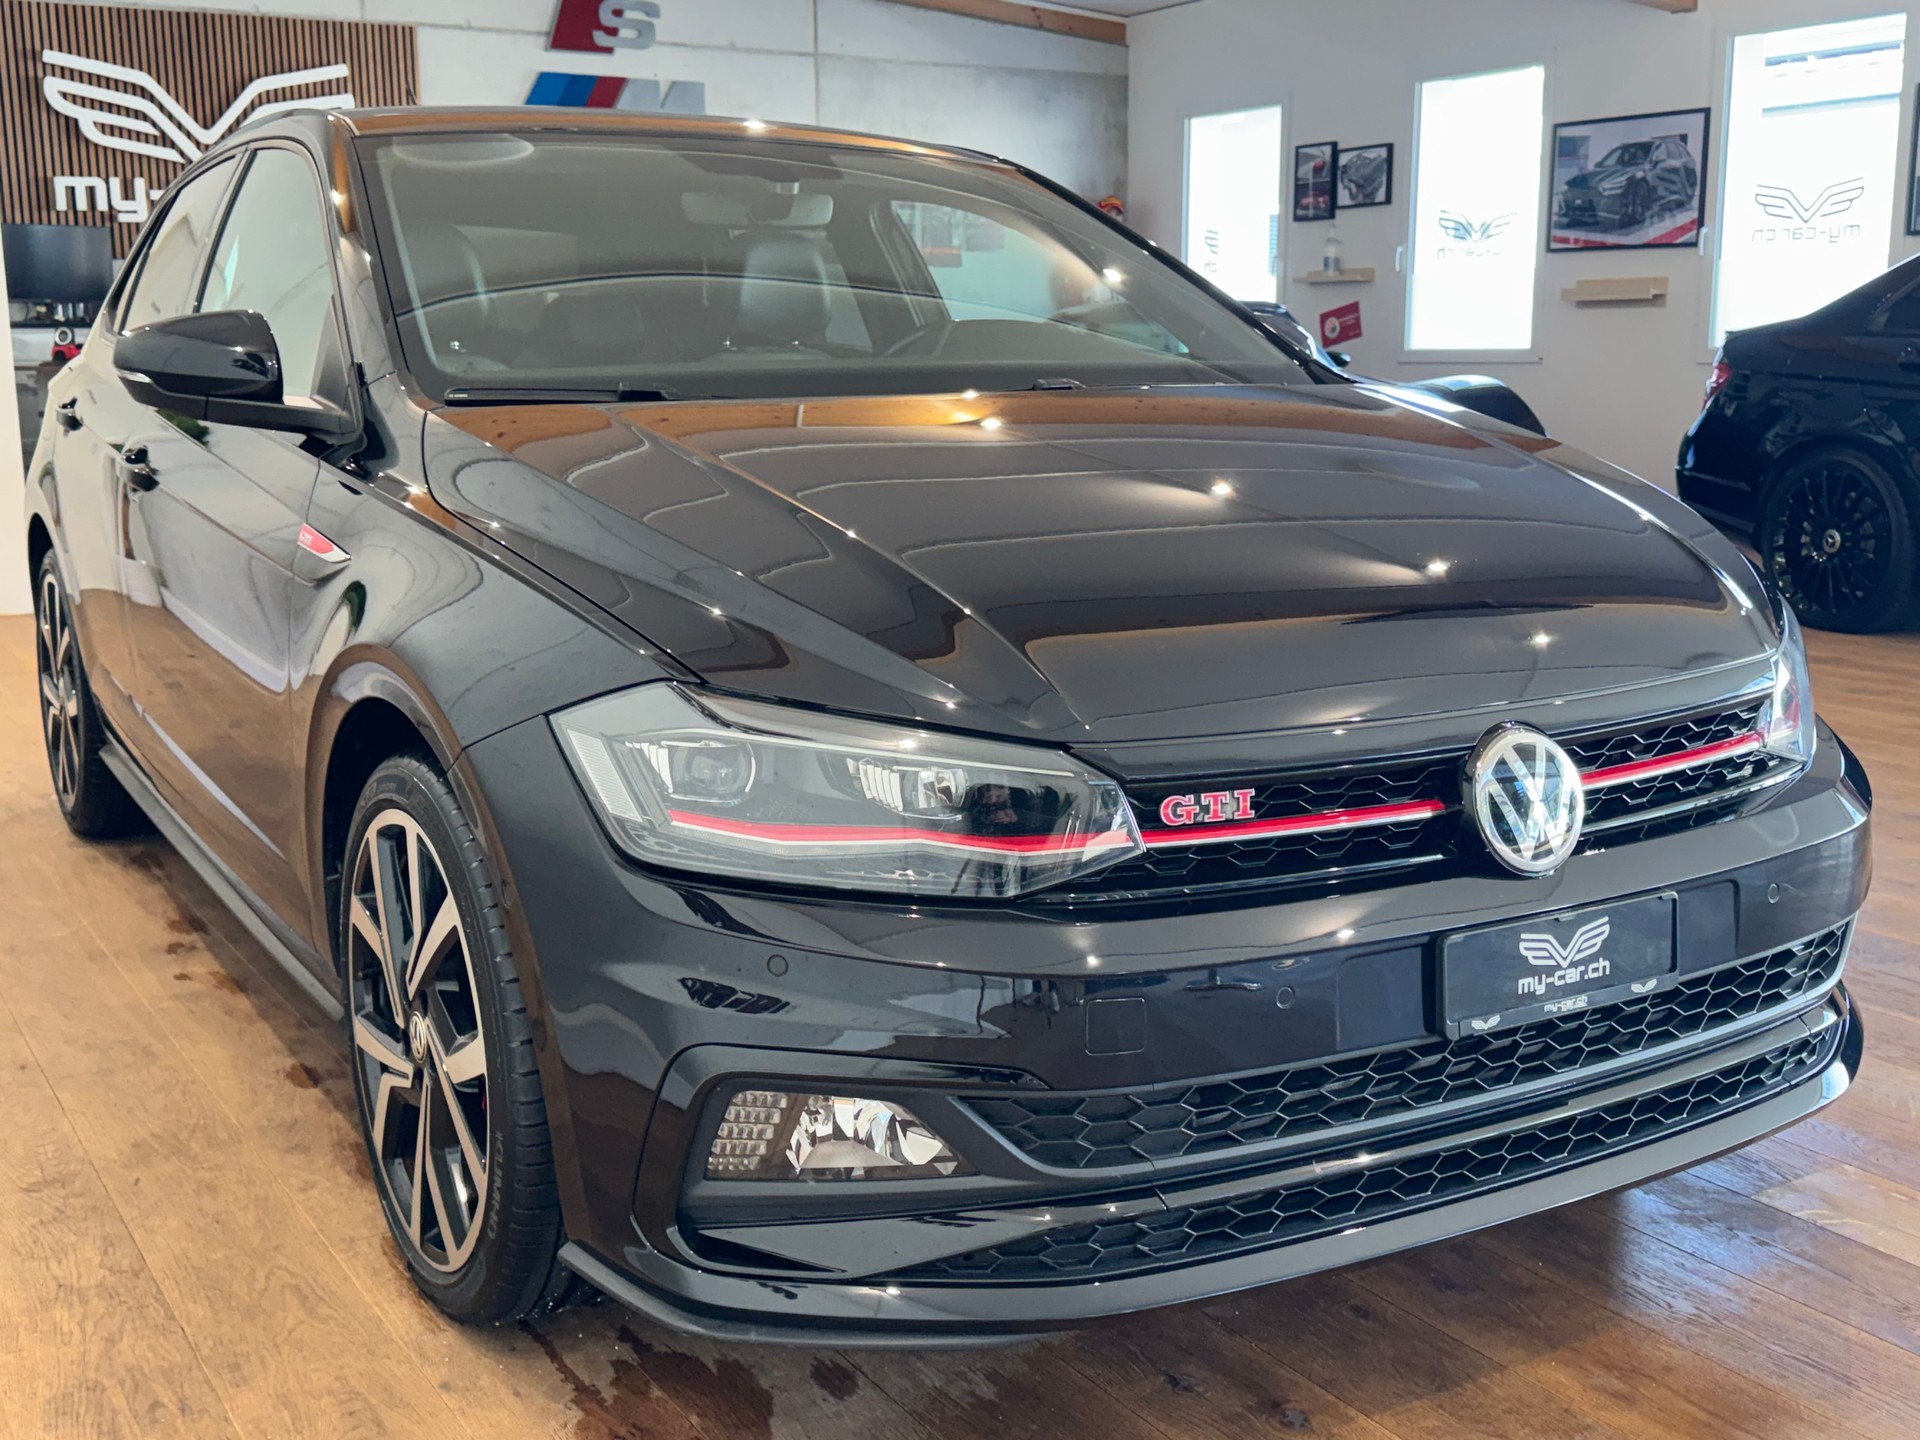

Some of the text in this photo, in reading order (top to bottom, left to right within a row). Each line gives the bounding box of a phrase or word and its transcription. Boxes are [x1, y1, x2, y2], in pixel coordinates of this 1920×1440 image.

[1160, 788, 1255, 826] GTI
[1518, 957, 1610, 995] my-car.ch
[1544, 995, 1588, 1012] my-car.ch
